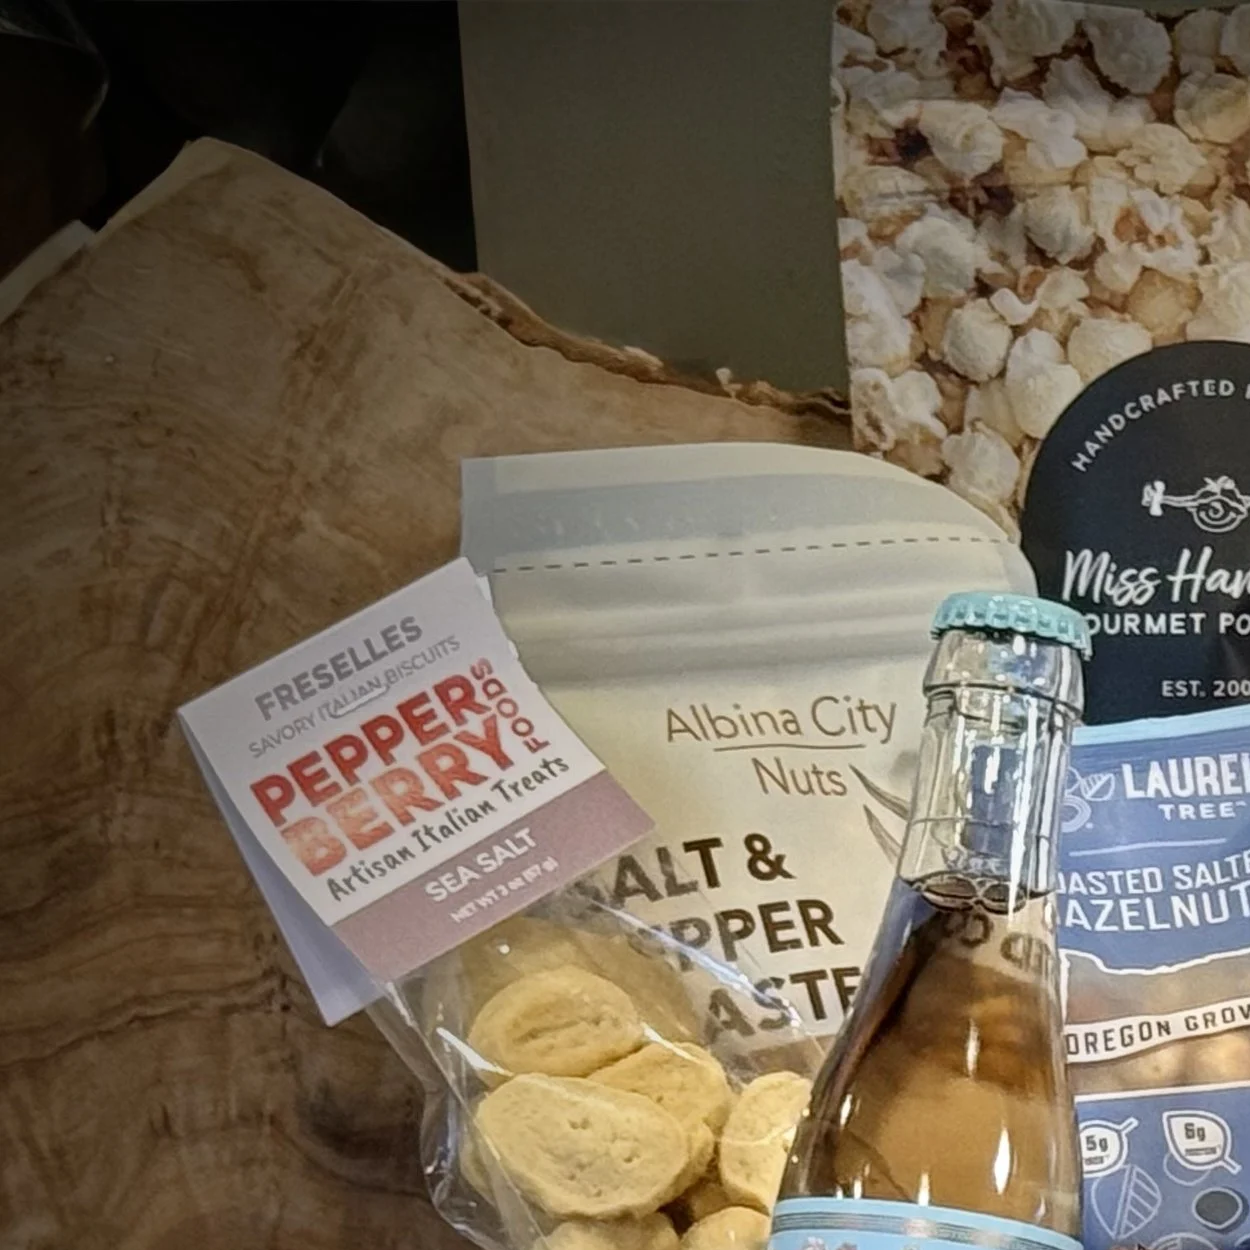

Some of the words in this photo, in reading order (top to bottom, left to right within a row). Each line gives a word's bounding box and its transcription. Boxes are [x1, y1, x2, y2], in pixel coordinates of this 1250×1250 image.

[1070, 379, 1236, 473] HANDCRAFTED
[1062, 547, 1162, 607] Miss
[1084, 612, 1206, 636] OURMET
[248, 711, 318, 759] SAVORY
[316, 674, 389, 723] ITALIAN
[385, 635, 462, 686] BISCUITS
[254, 616, 424, 723] FRESELLES
[468, 657, 551, 755] FOODS
[1161, 679, 1207, 698] EST.
[249, 674, 493, 828] PEPPER
[666, 703, 801, 743] Albina
[809, 695, 898, 745] City
[279, 714, 516, 878] BERRY
[751, 756, 848, 797] Nuts
[327, 845, 416, 902] Artisan
[411, 799, 498, 853] Italian
[491, 752, 571, 804] Treats
[424, 865, 483, 902] SEA
[475, 827, 538, 873] SALT
[609, 836, 724, 909] ALT
[742, 832, 797, 882] &
[1066, 1019, 1172, 1057] OREGON
